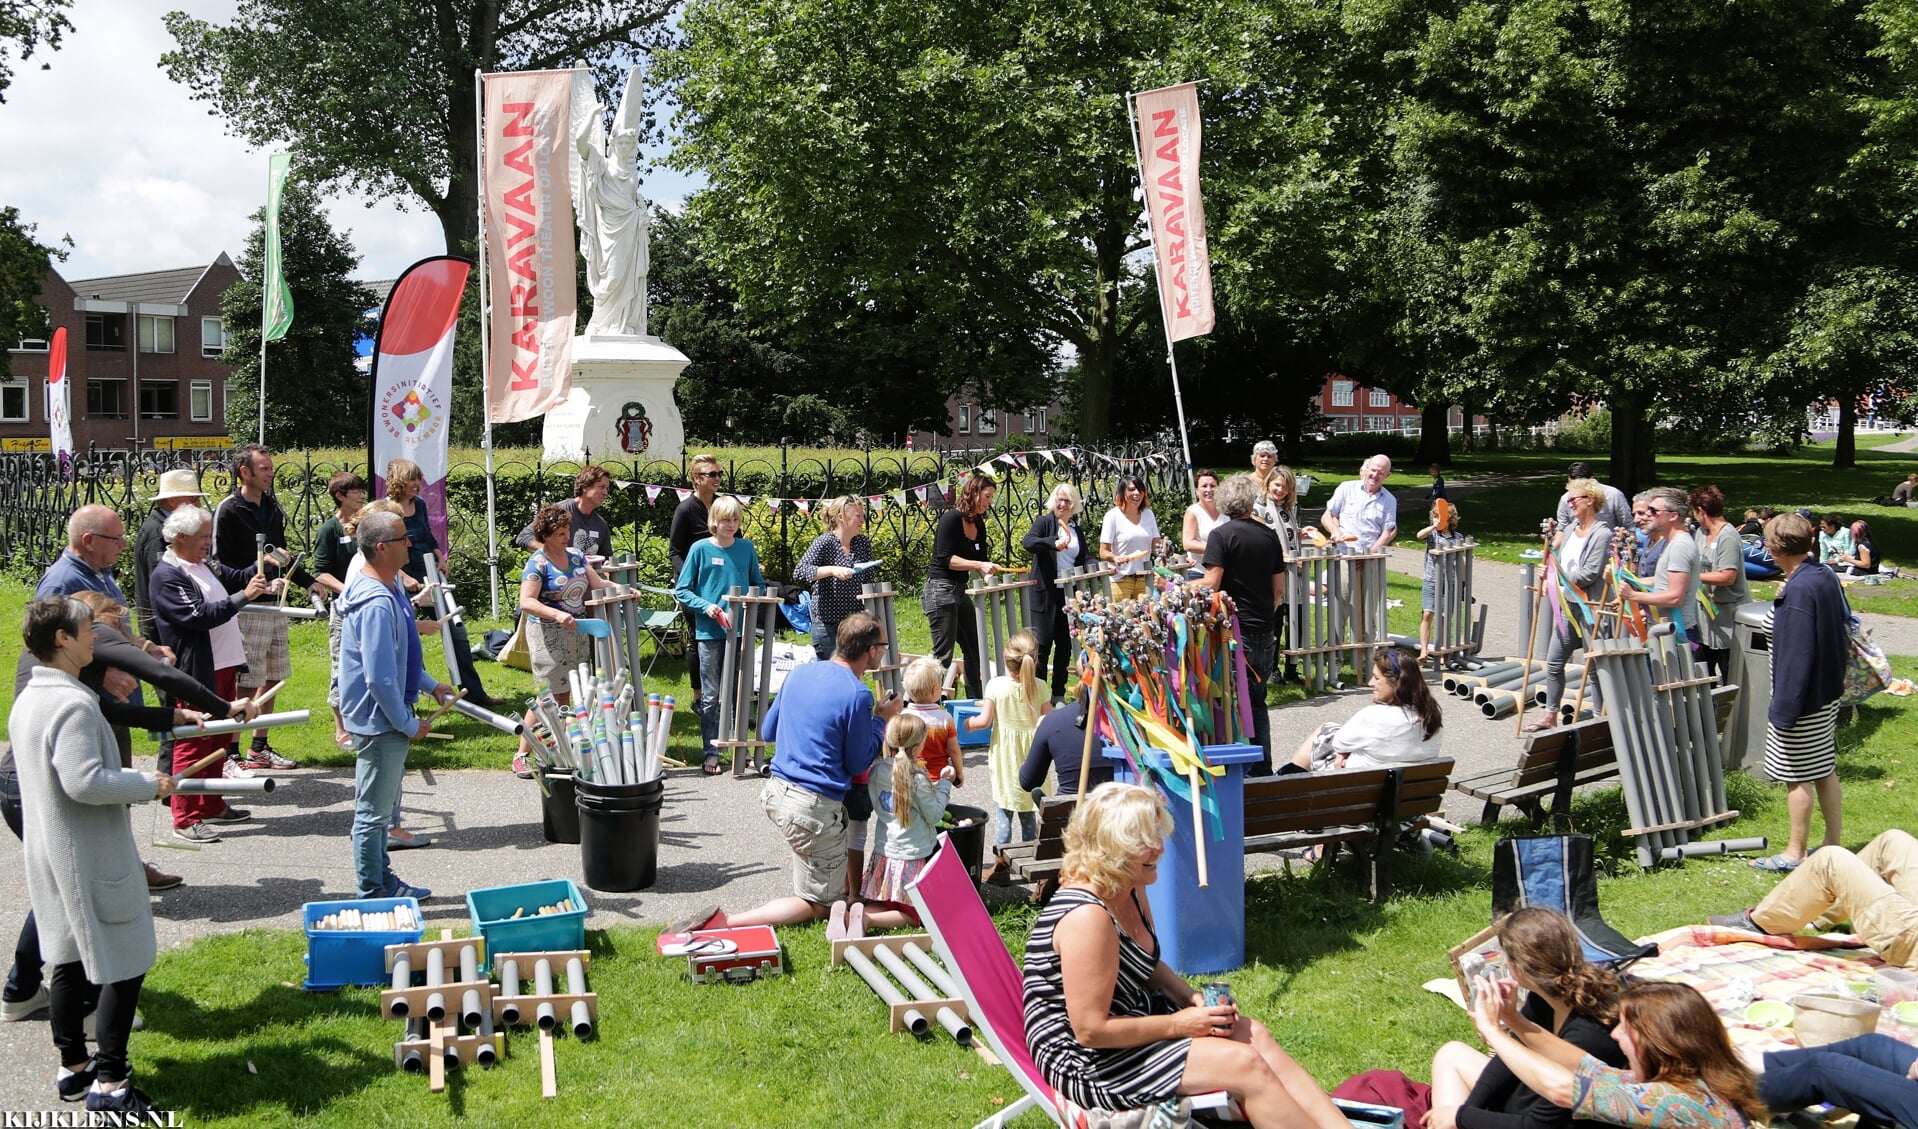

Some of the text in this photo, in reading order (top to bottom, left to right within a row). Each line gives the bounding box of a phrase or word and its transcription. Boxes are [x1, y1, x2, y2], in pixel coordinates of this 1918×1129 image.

[539, 169, 550, 188] OP
[502, 102, 540, 392] KARAVAAN
[540, 193, 553, 261] THEATER
[1151, 108, 1191, 319] KARAVAAN
[405, 415, 441, 444] ALKMAAR
